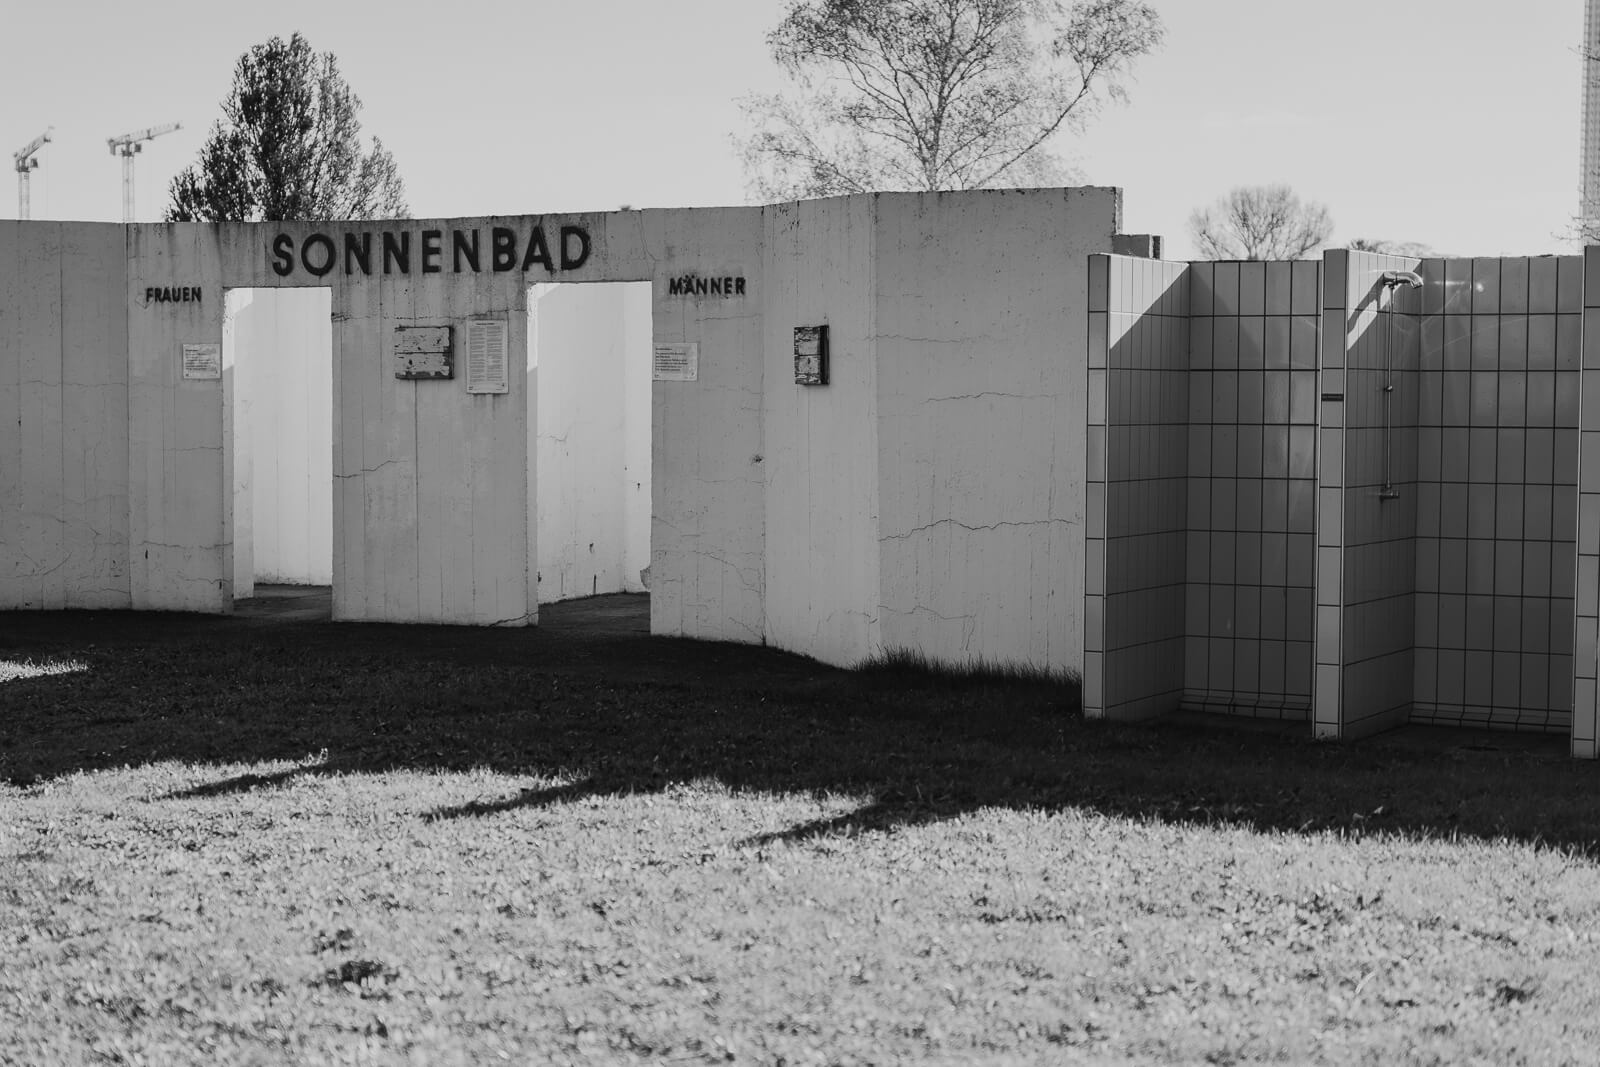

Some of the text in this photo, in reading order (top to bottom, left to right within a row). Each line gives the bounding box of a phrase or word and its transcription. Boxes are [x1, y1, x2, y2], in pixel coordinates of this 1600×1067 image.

[272, 226, 591, 276] SONNENBAD
[146, 286, 202, 303] FRAUEN
[669, 275, 745, 295] MÄNNER
